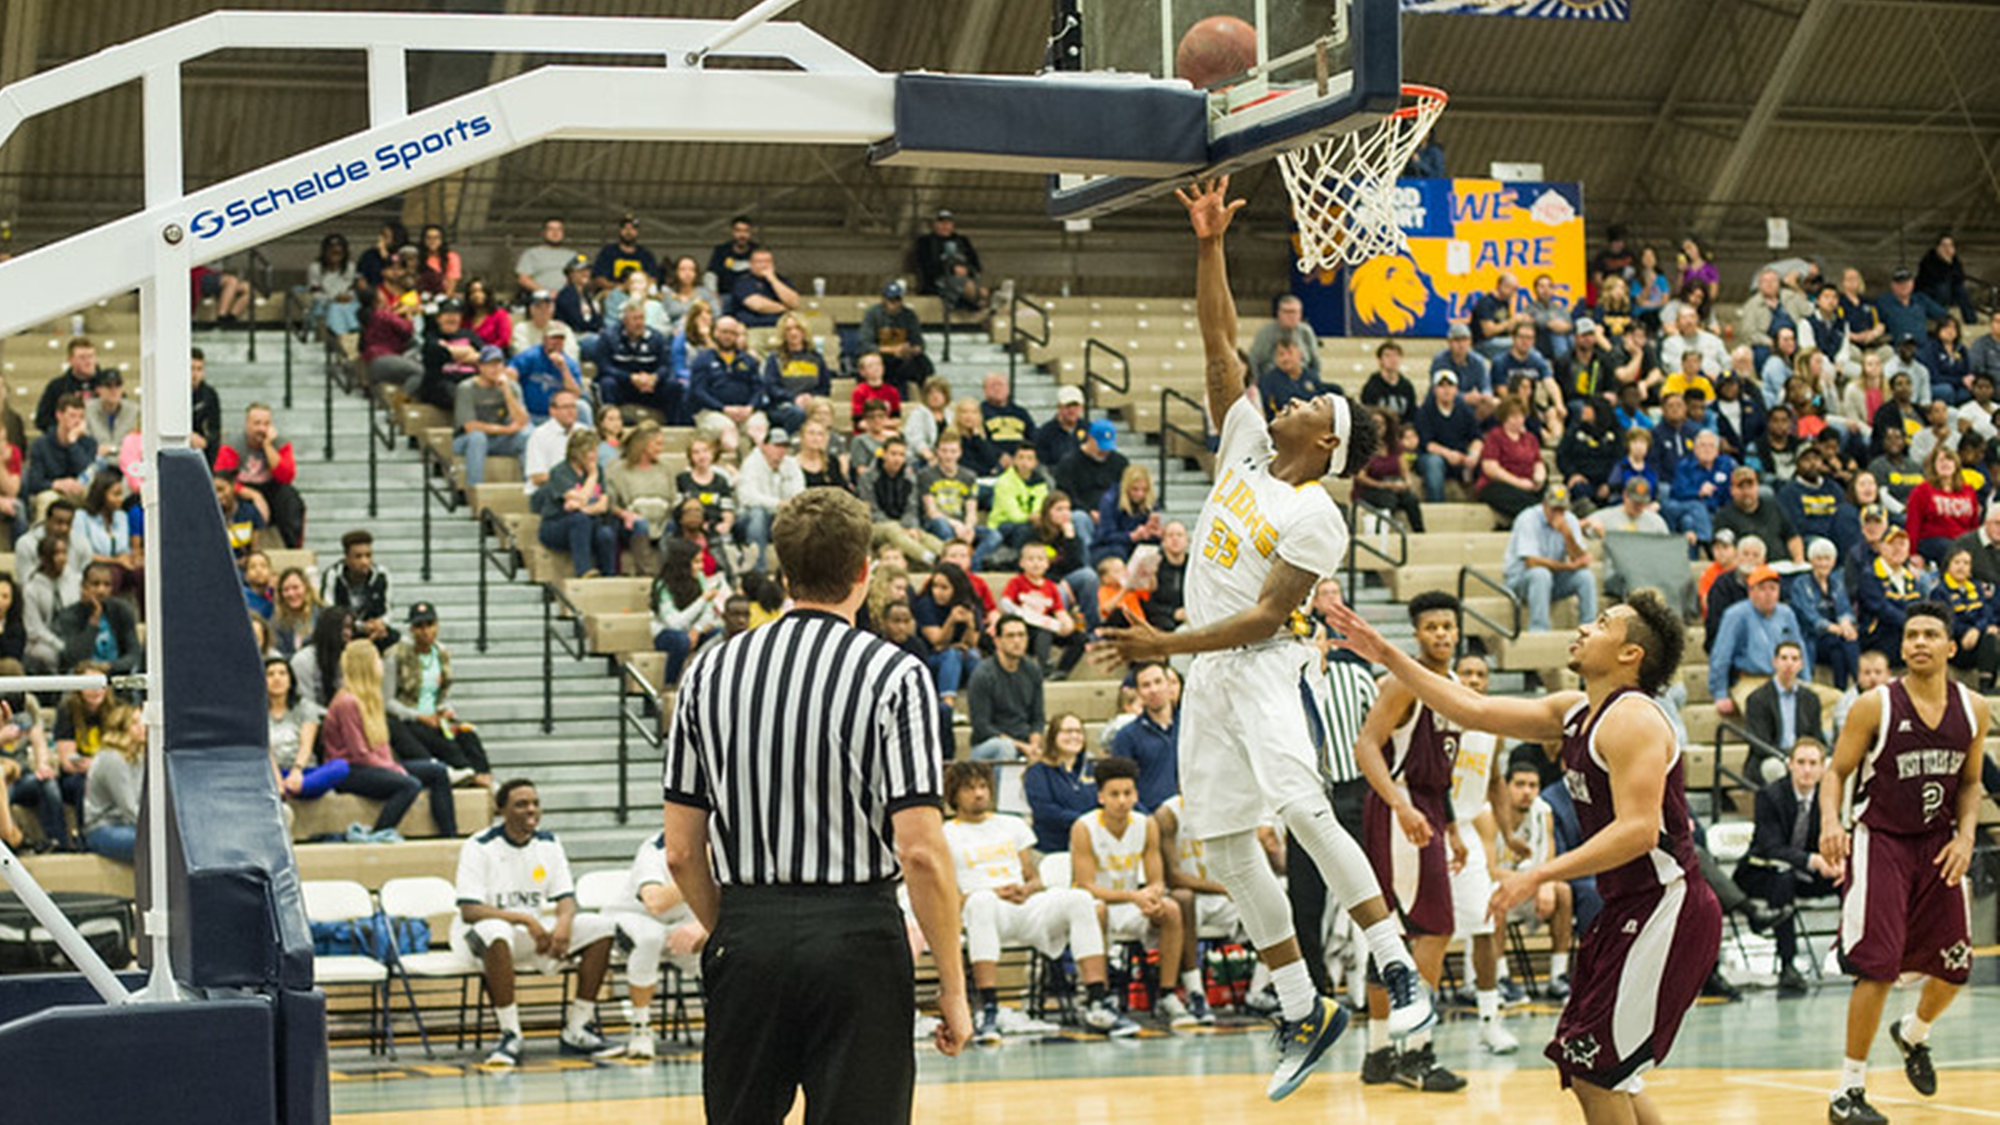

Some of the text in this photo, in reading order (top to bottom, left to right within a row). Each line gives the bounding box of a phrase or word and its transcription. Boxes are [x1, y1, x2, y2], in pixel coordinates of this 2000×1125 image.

[225, 115, 492, 226] Schelde Sports
[1449, 188, 1518, 222] WE
[1475, 237, 1555, 270] ARE
[1212, 469, 1279, 559] LIONS
